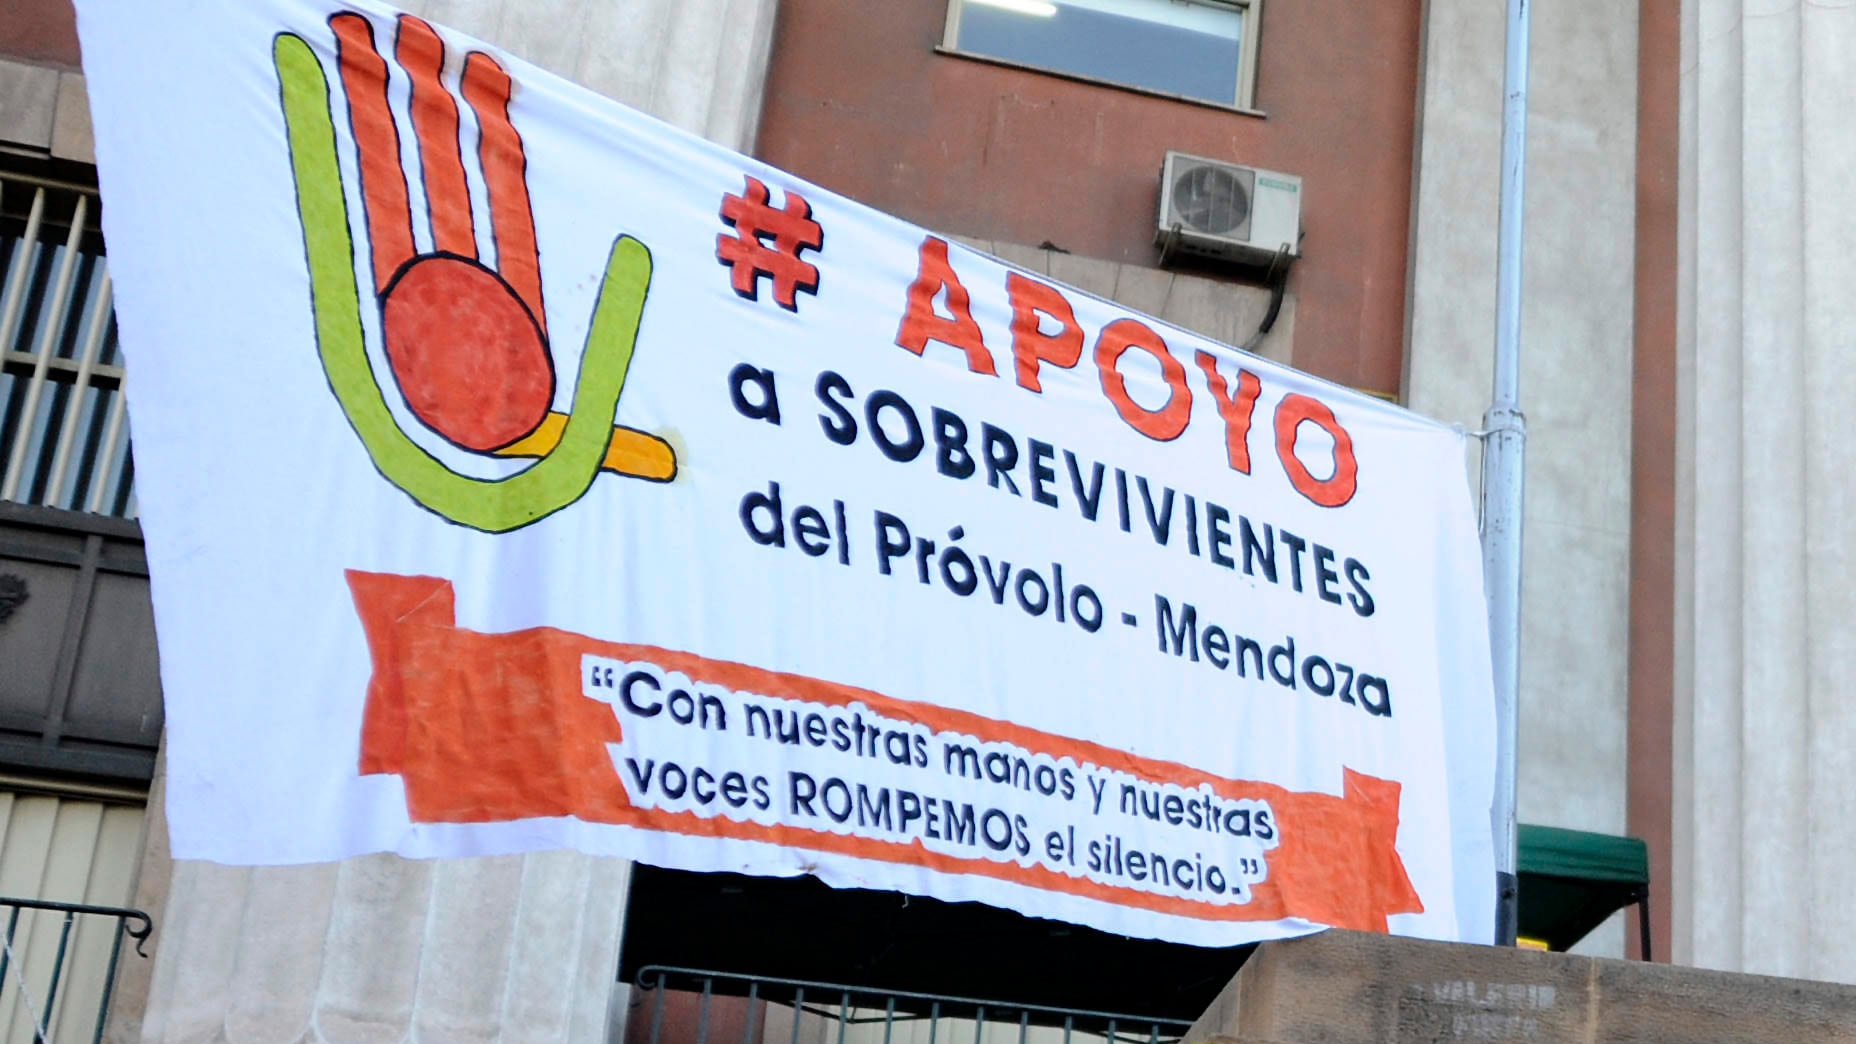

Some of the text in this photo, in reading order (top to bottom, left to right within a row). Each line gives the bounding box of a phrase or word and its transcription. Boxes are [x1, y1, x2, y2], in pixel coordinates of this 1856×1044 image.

[715, 174, 1358, 508] # APOYO
[728, 362, 1376, 618] a SOBREVIVIENTES
[738, 481, 848, 567] del
[876, 526, 1103, 633] Próvolo
[1154, 594, 1394, 719] Mendoza
[625, 755, 770, 809] voces
[790, 771, 1031, 854] ROMPEMOS
[1044, 826, 1075, 868] el
[744, 701, 929, 770] nuestras
[943, 740, 1075, 803] manos
[1087, 775, 1106, 817] y
[1119, 783, 1274, 842] nuestras
